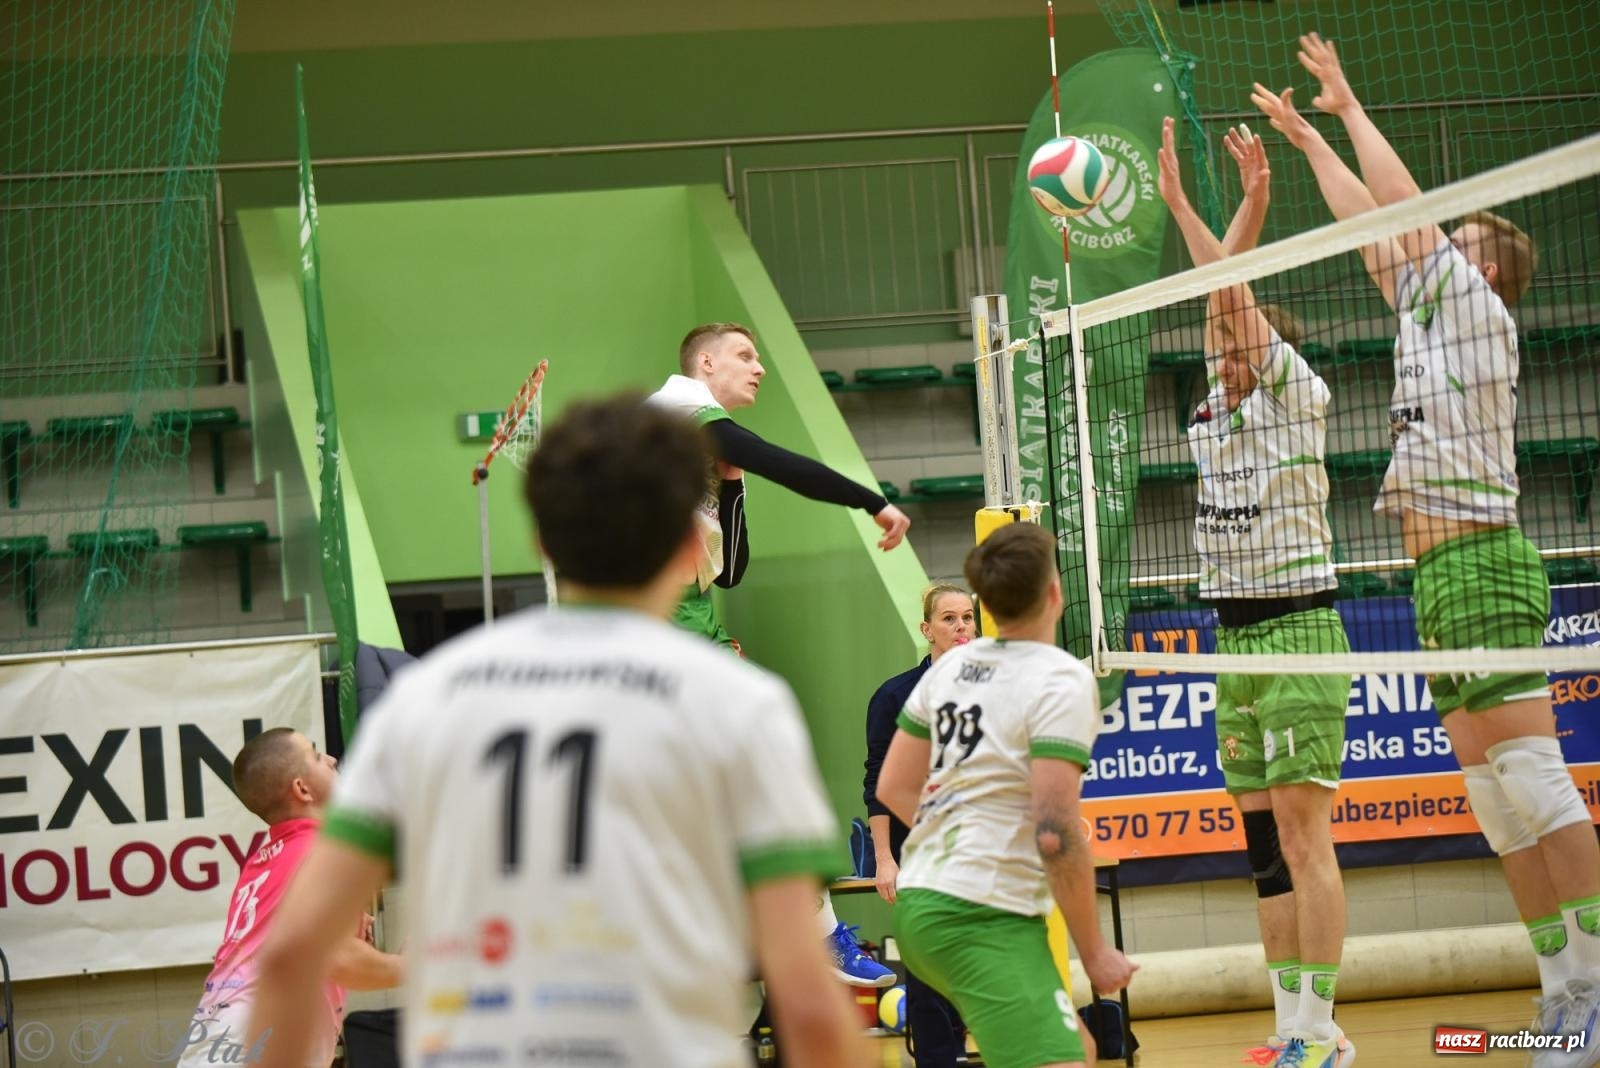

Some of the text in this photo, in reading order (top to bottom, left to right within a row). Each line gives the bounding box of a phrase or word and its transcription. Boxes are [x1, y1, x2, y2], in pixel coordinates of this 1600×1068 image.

[1083, 745, 1208, 782] acibórz,
[1283, 727, 1295, 757] 1
[478, 724, 603, 878] 11
[1095, 814, 1149, 841] 570
[1156, 810, 1190, 836] 77
[1199, 807, 1235, 833] 55
[1331, 792, 1474, 825] ubezpiecz
